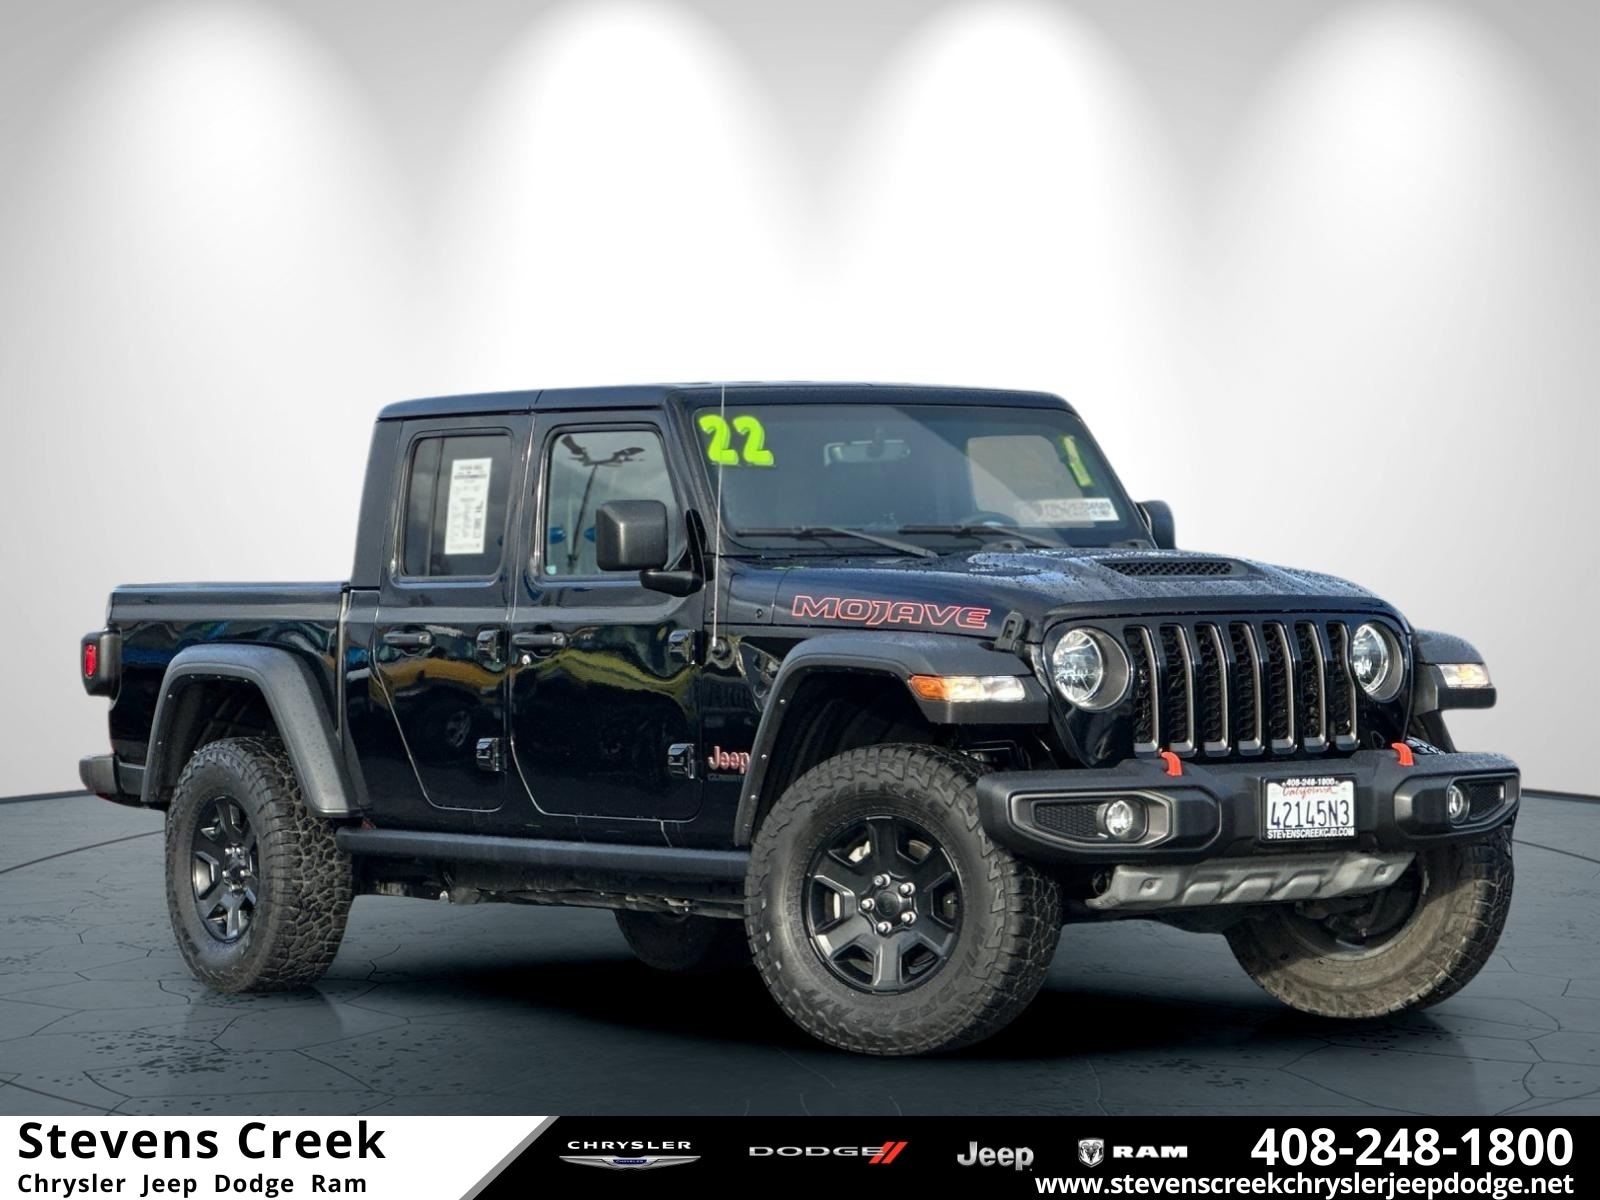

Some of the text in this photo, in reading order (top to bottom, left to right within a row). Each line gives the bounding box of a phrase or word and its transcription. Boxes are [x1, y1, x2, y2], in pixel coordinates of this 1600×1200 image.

[699, 414, 775, 466] 22
[791, 595, 991, 629] MOJAVE
[707, 745, 751, 775] Jeep
[1282, 786, 1337, 799] California
[1271, 800, 1350, 828] 42145N3
